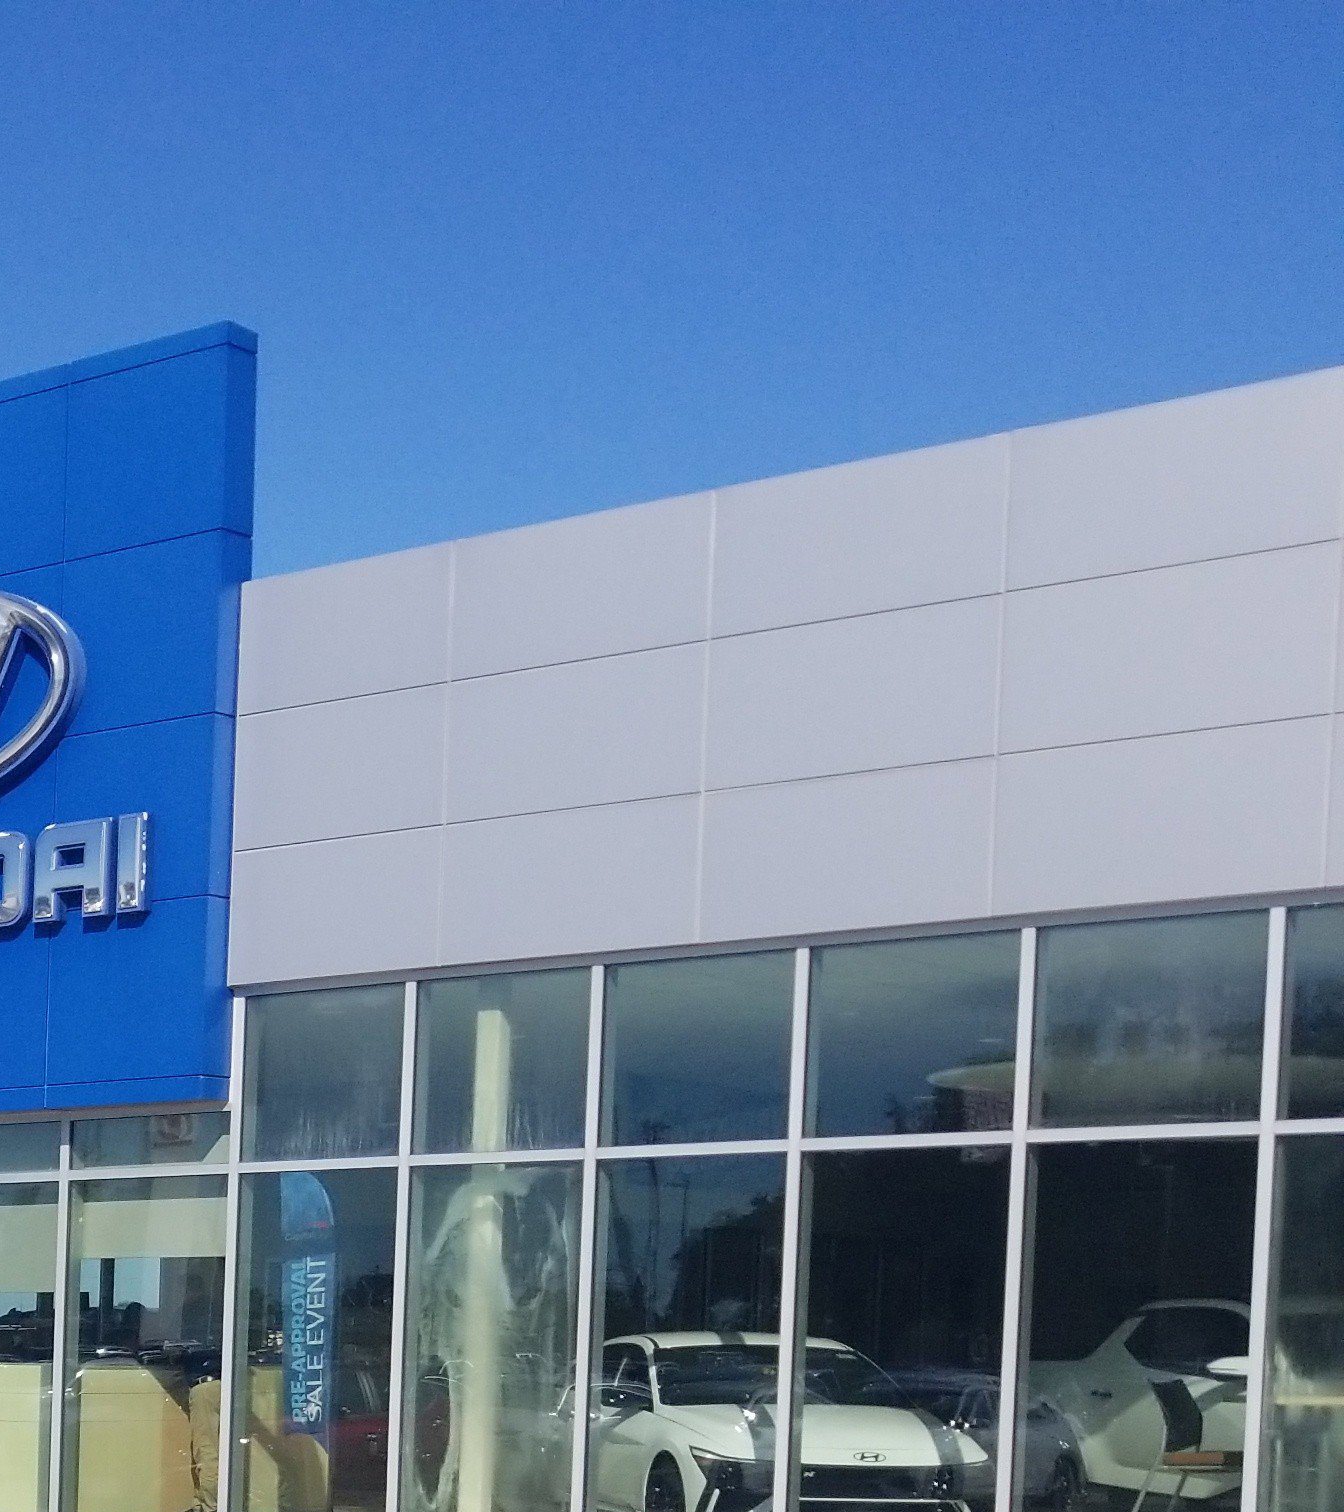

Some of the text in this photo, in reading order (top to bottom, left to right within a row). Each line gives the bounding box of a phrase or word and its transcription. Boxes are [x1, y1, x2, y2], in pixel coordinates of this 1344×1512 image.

[290, 1257, 307, 1423] PRE-APPROVAL
[306, 1256, 326, 1423] SALE EVENT
